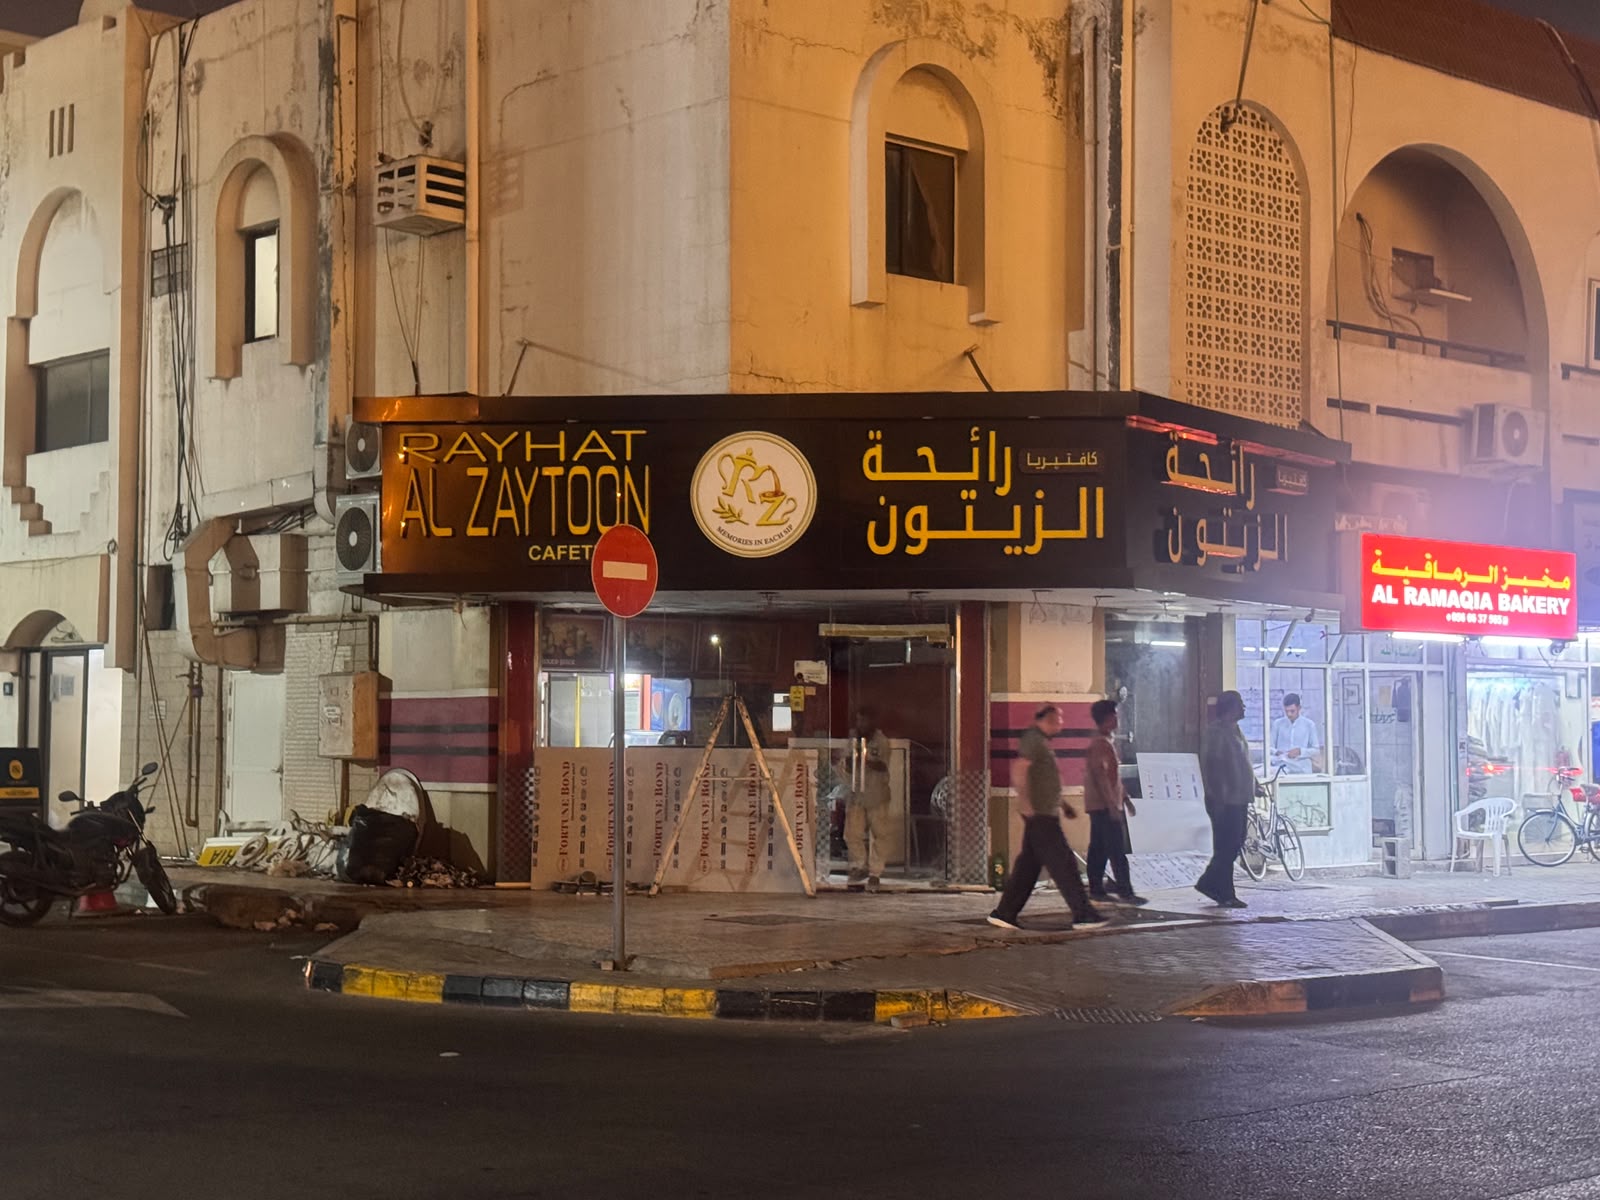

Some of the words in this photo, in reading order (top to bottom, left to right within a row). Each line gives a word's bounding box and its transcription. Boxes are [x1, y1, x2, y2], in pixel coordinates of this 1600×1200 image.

[400, 429, 648, 463] RAYHAT
[862, 426, 1012, 497] رائحة
[1026, 451, 1098, 469] كافتيريا
[1166, 432, 1255, 510] رائحة
[401, 466, 452, 537] AL
[466, 464, 649, 537] ZAYTOON
[867, 486, 1104, 556] الزيتون
[528, 545, 593, 561] CAFET
[717, 525, 754, 546] MEMORIES
[754, 537, 763, 546] IN
[764, 531, 784, 544] EACH
[783, 523, 794, 536] SIP
[1168, 505, 1288, 574] الزيتون
[1371, 584, 1398, 604] AL
[1403, 586, 1493, 611] RAMAQIA
[1498, 593, 1571, 615] BAKERY
[1501, 566, 1571, 594] مخبز
[561, 761, 570, 796] BOND
[654, 762, 663, 796] BOND
[795, 764, 804, 798] BOND
[559, 800, 569, 856] FORTUNE
[653, 800, 663, 857] FORTUNE
[700, 801, 710, 858] FORTUNE
[747, 801, 757, 858] FORTUNE
[796, 801, 804, 861] ORTUNE
